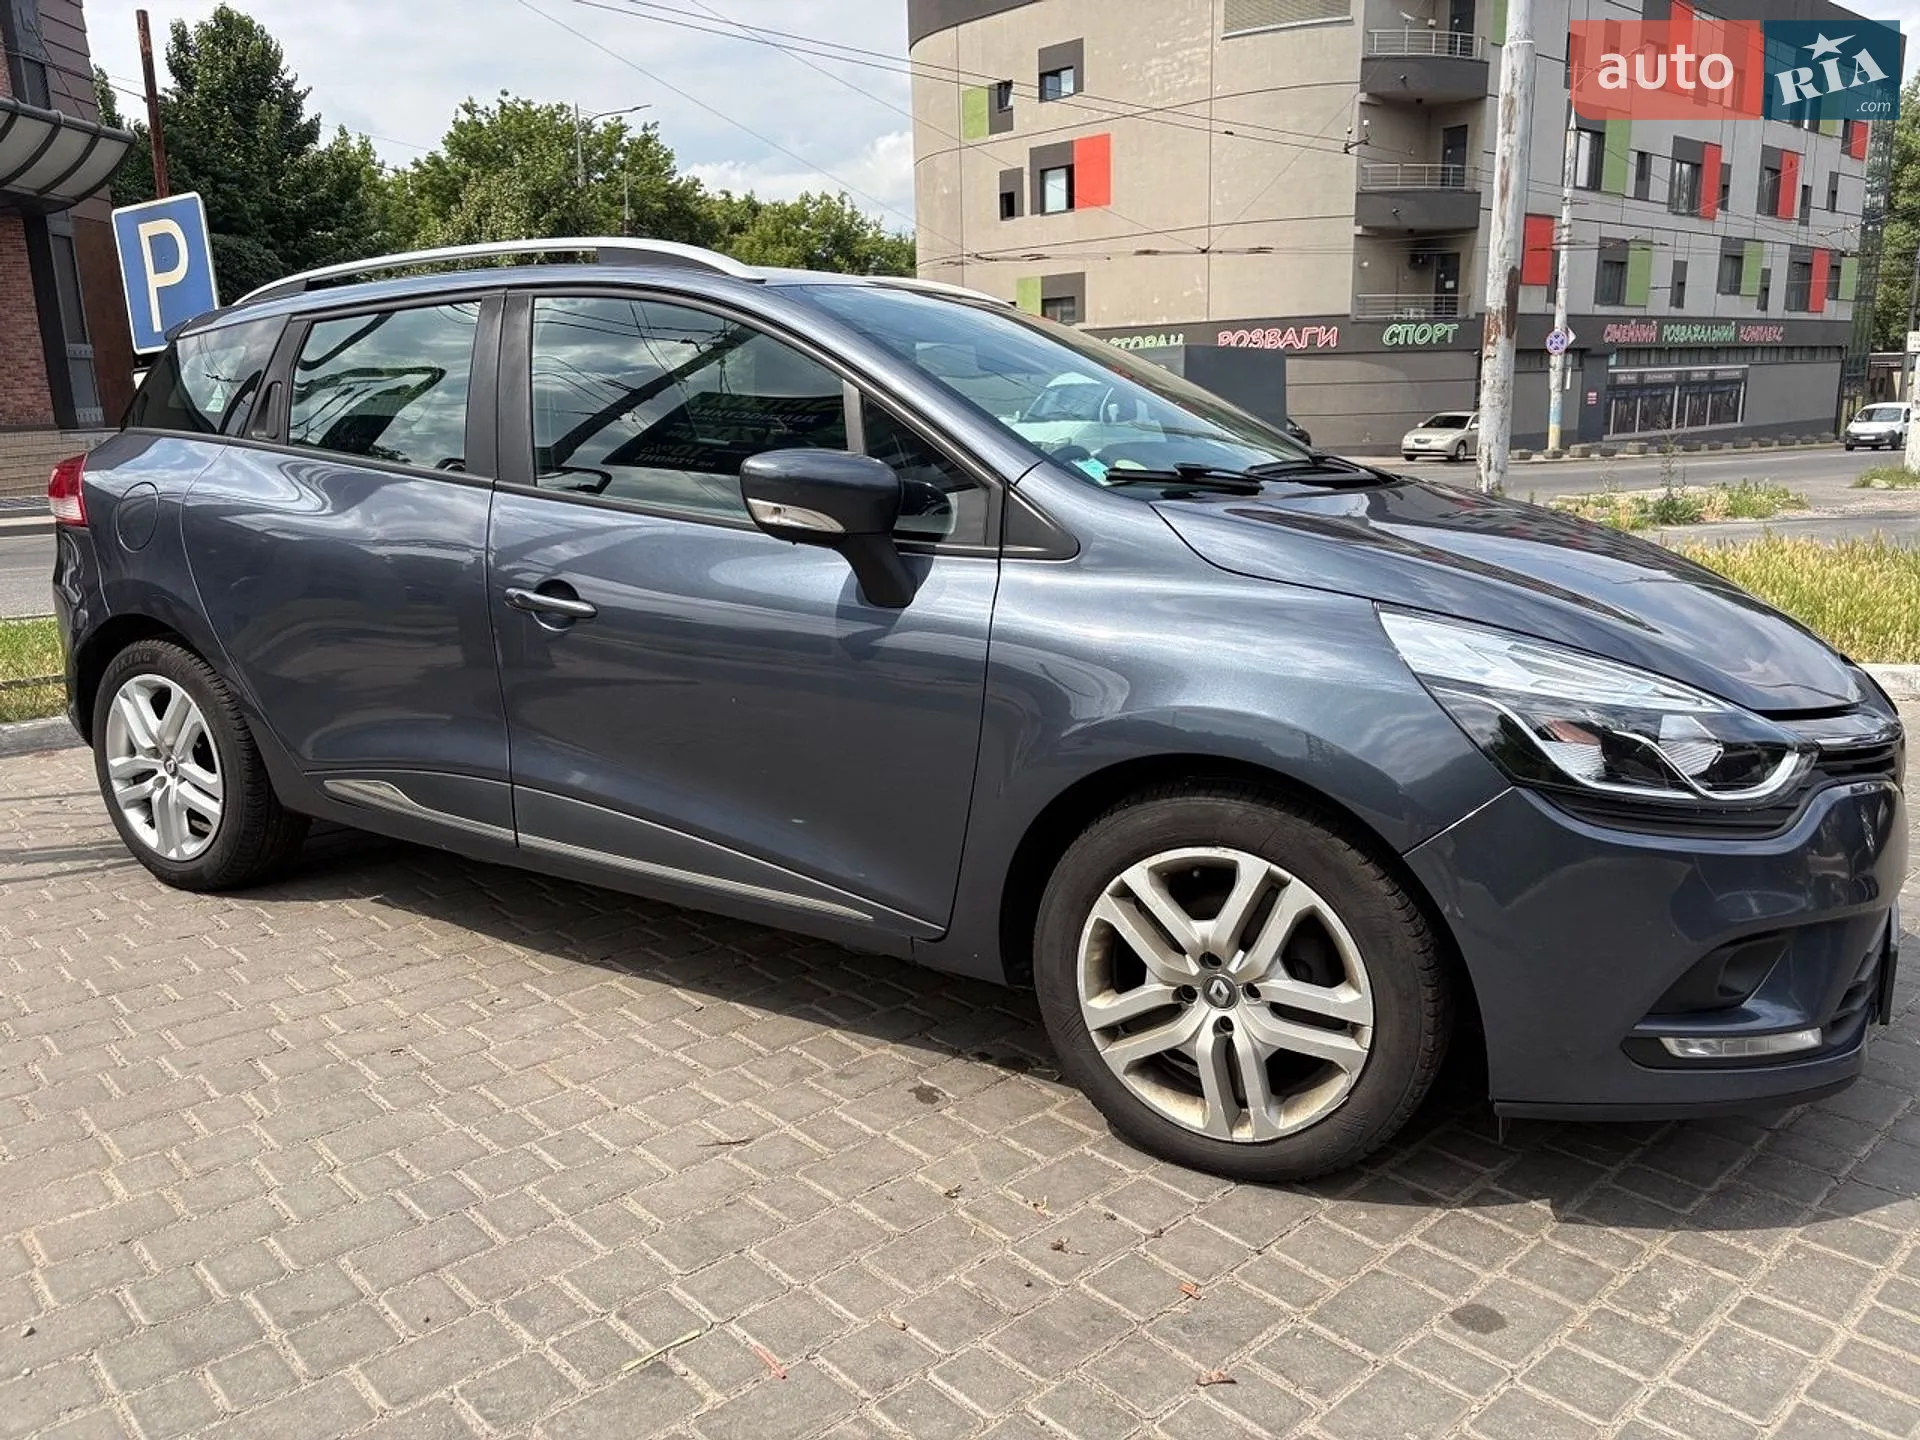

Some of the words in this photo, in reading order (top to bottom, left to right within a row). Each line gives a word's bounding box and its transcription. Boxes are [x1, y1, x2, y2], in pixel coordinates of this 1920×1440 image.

[138, 218, 189, 333] P
[1217, 325, 1338, 349] РОЗВАГИ
[1382, 323, 1459, 346] СПОРТ
